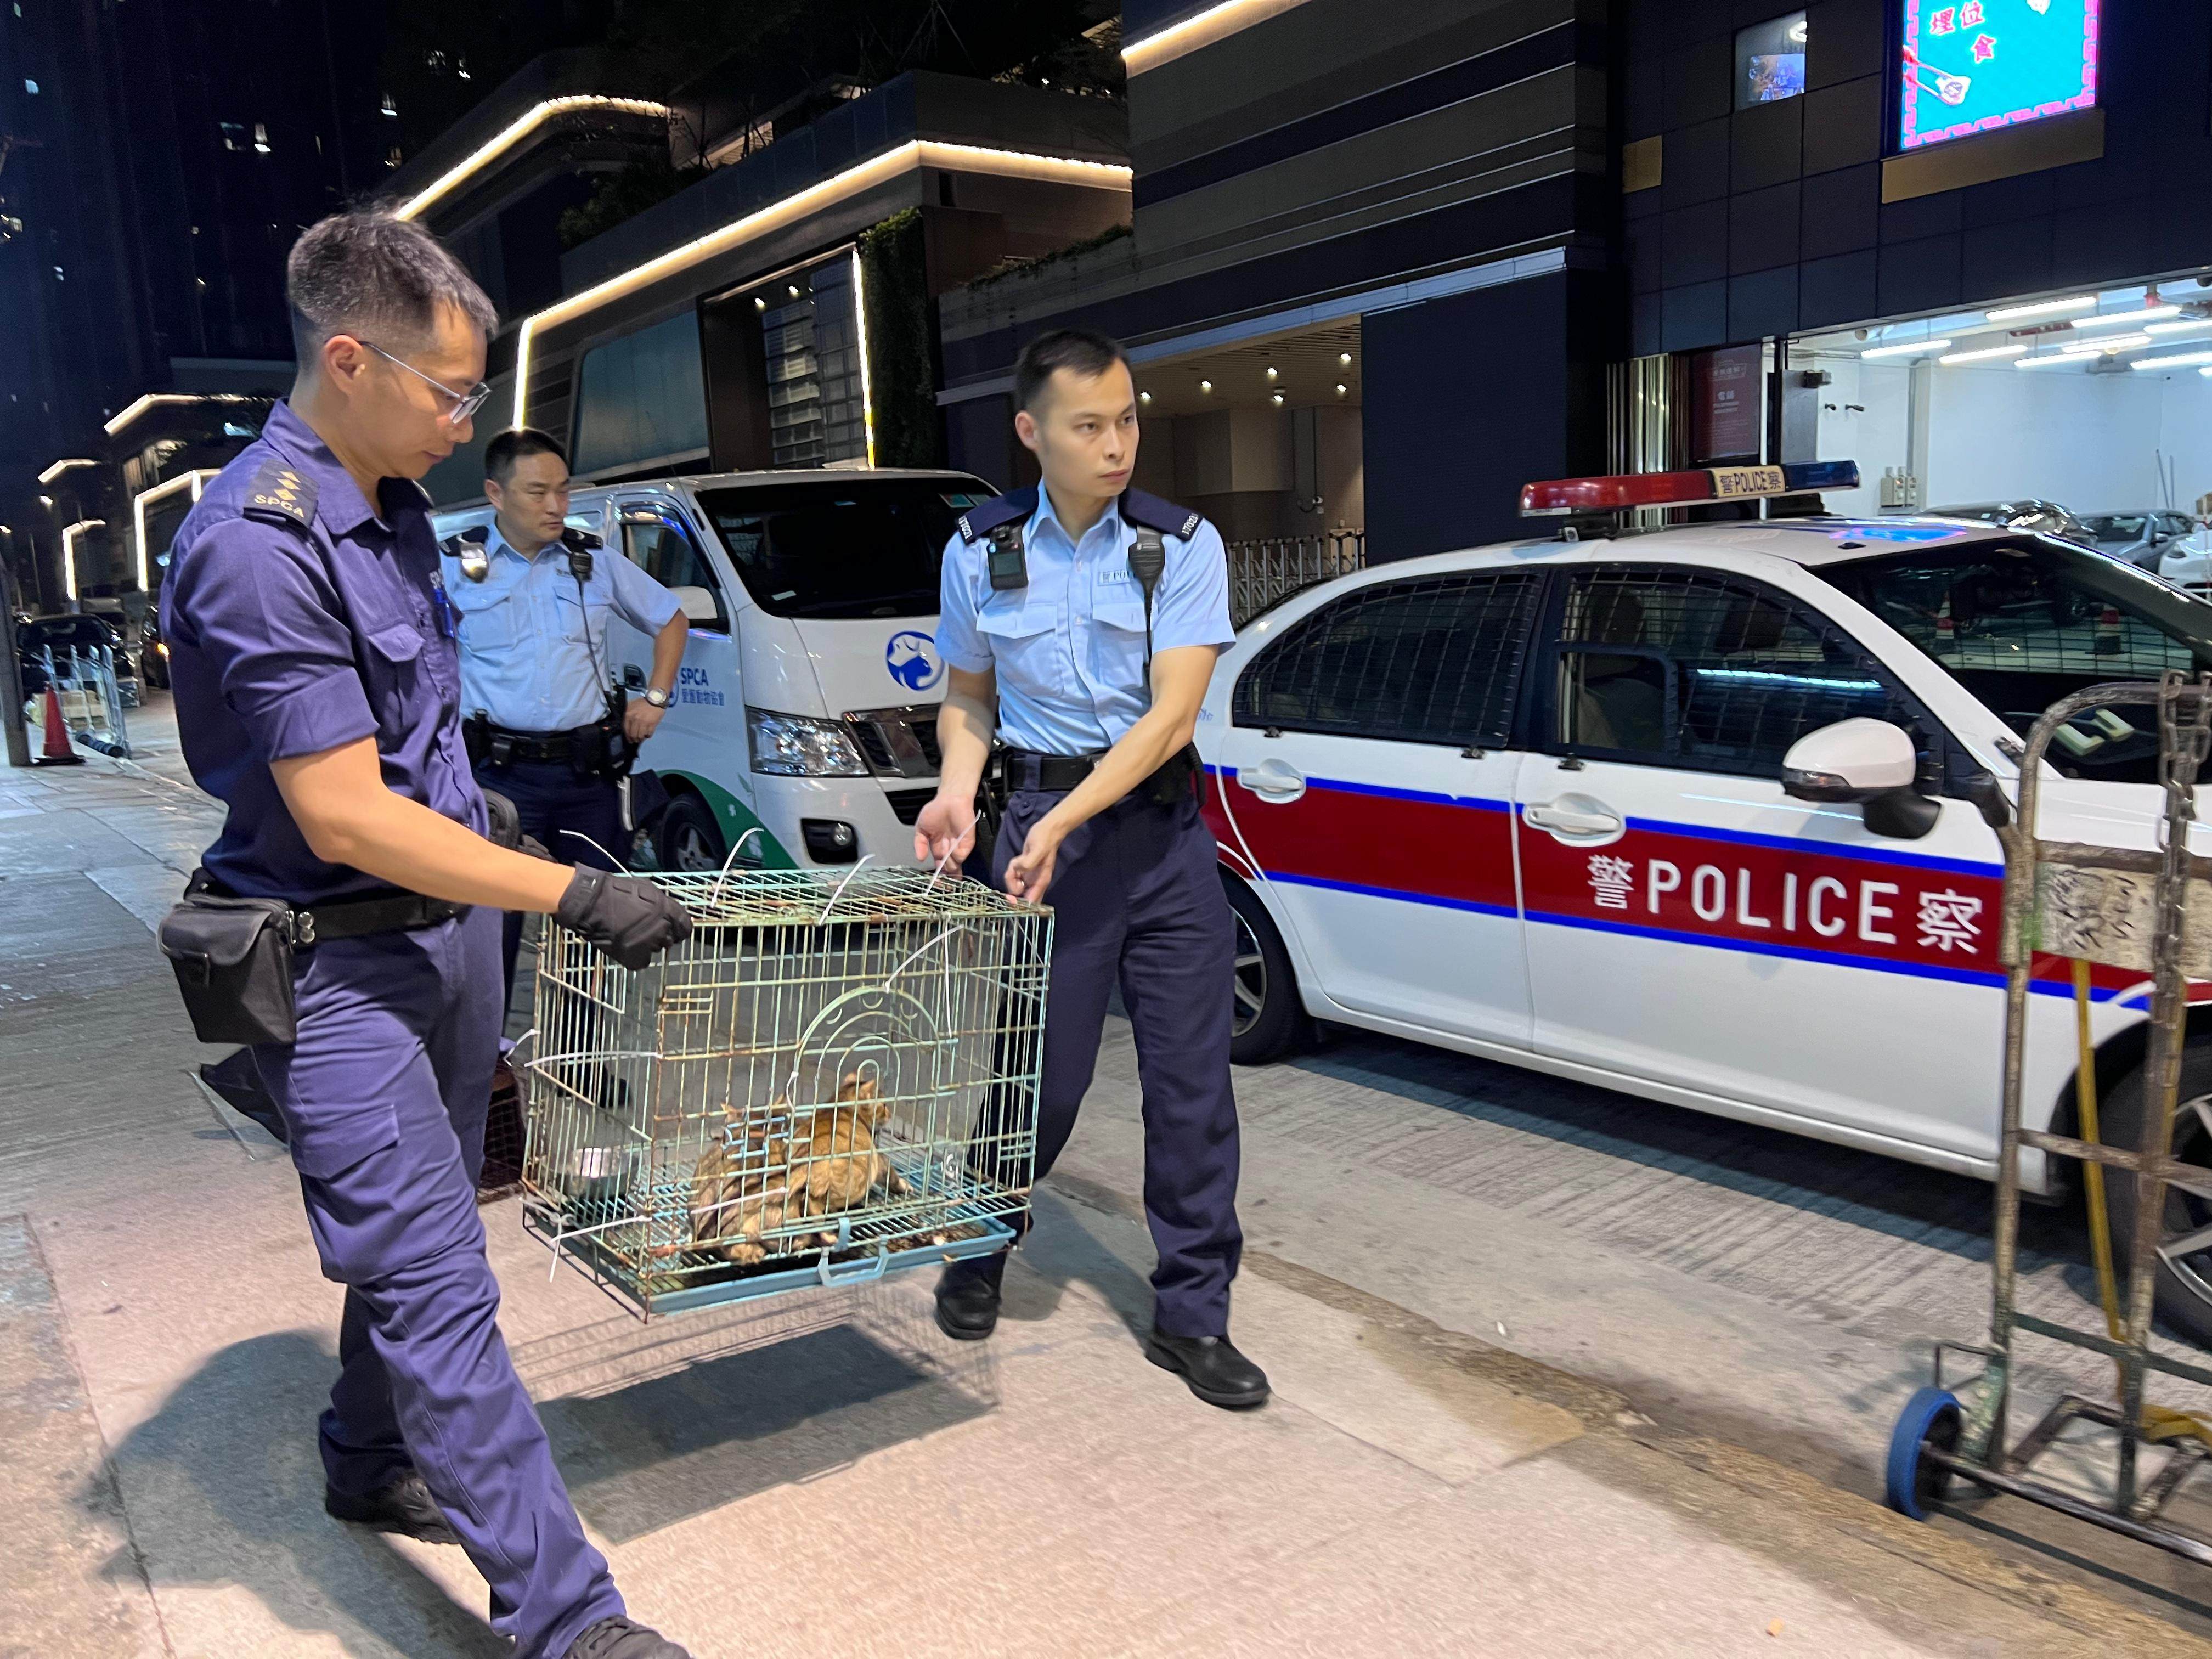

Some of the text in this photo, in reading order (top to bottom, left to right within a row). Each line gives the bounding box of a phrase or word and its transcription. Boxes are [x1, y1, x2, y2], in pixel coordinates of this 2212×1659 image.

[1930, 1, 1984, 34] 埋位
[1734, 471, 1768, 493] POLICE
[254, 494, 304, 518] SPCA
[681, 667, 709, 686] SPCA
[1587, 854, 1634, 910] 警
[1647, 859, 1899, 945] POLICE
[1916, 888, 1983, 955] 察
